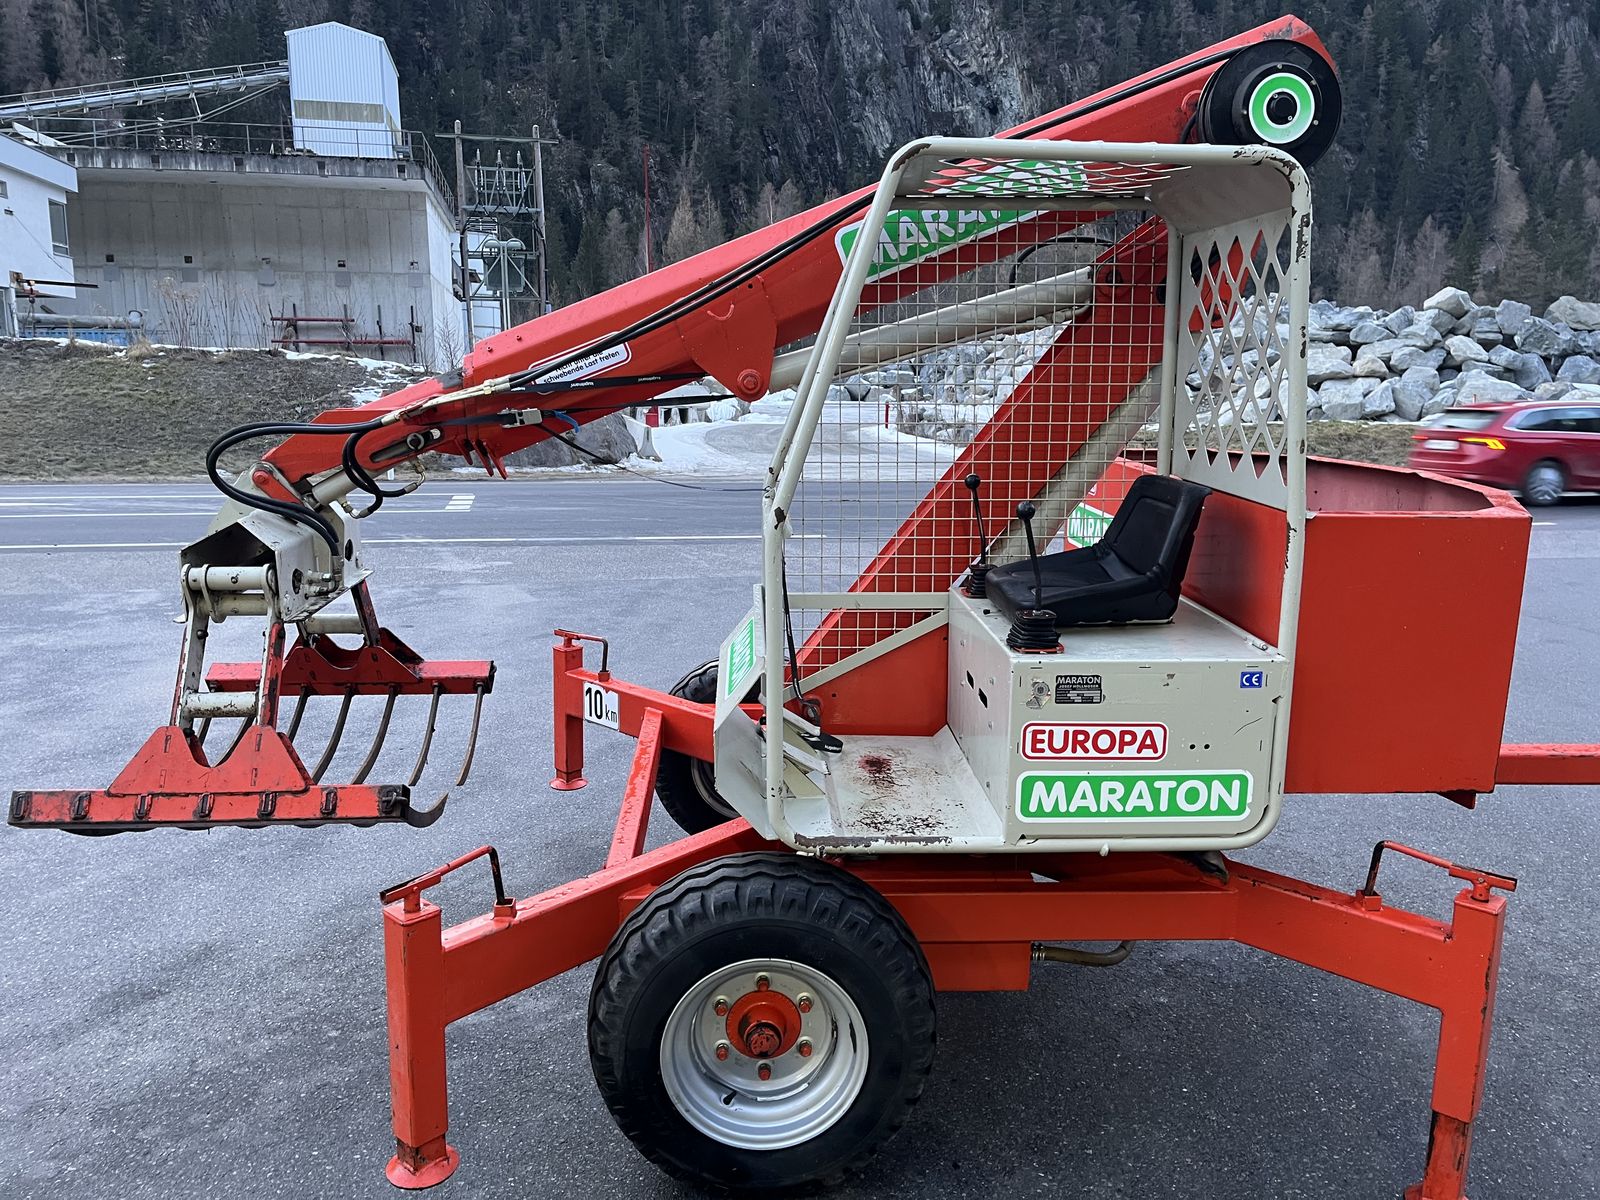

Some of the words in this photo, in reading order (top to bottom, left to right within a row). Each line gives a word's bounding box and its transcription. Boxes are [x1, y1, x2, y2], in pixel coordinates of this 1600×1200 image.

[543, 365, 585, 383] schwebende
[584, 358, 599, 368] Last
[599, 350, 620, 363] treten
[1056, 676, 1101, 684] MARATON
[1242, 673, 1260, 686] CE
[585, 686, 603, 720] 10
[605, 704, 618, 723] km
[1031, 729, 1159, 754] EUROPA
[1028, 779, 1241, 813] MARATON
